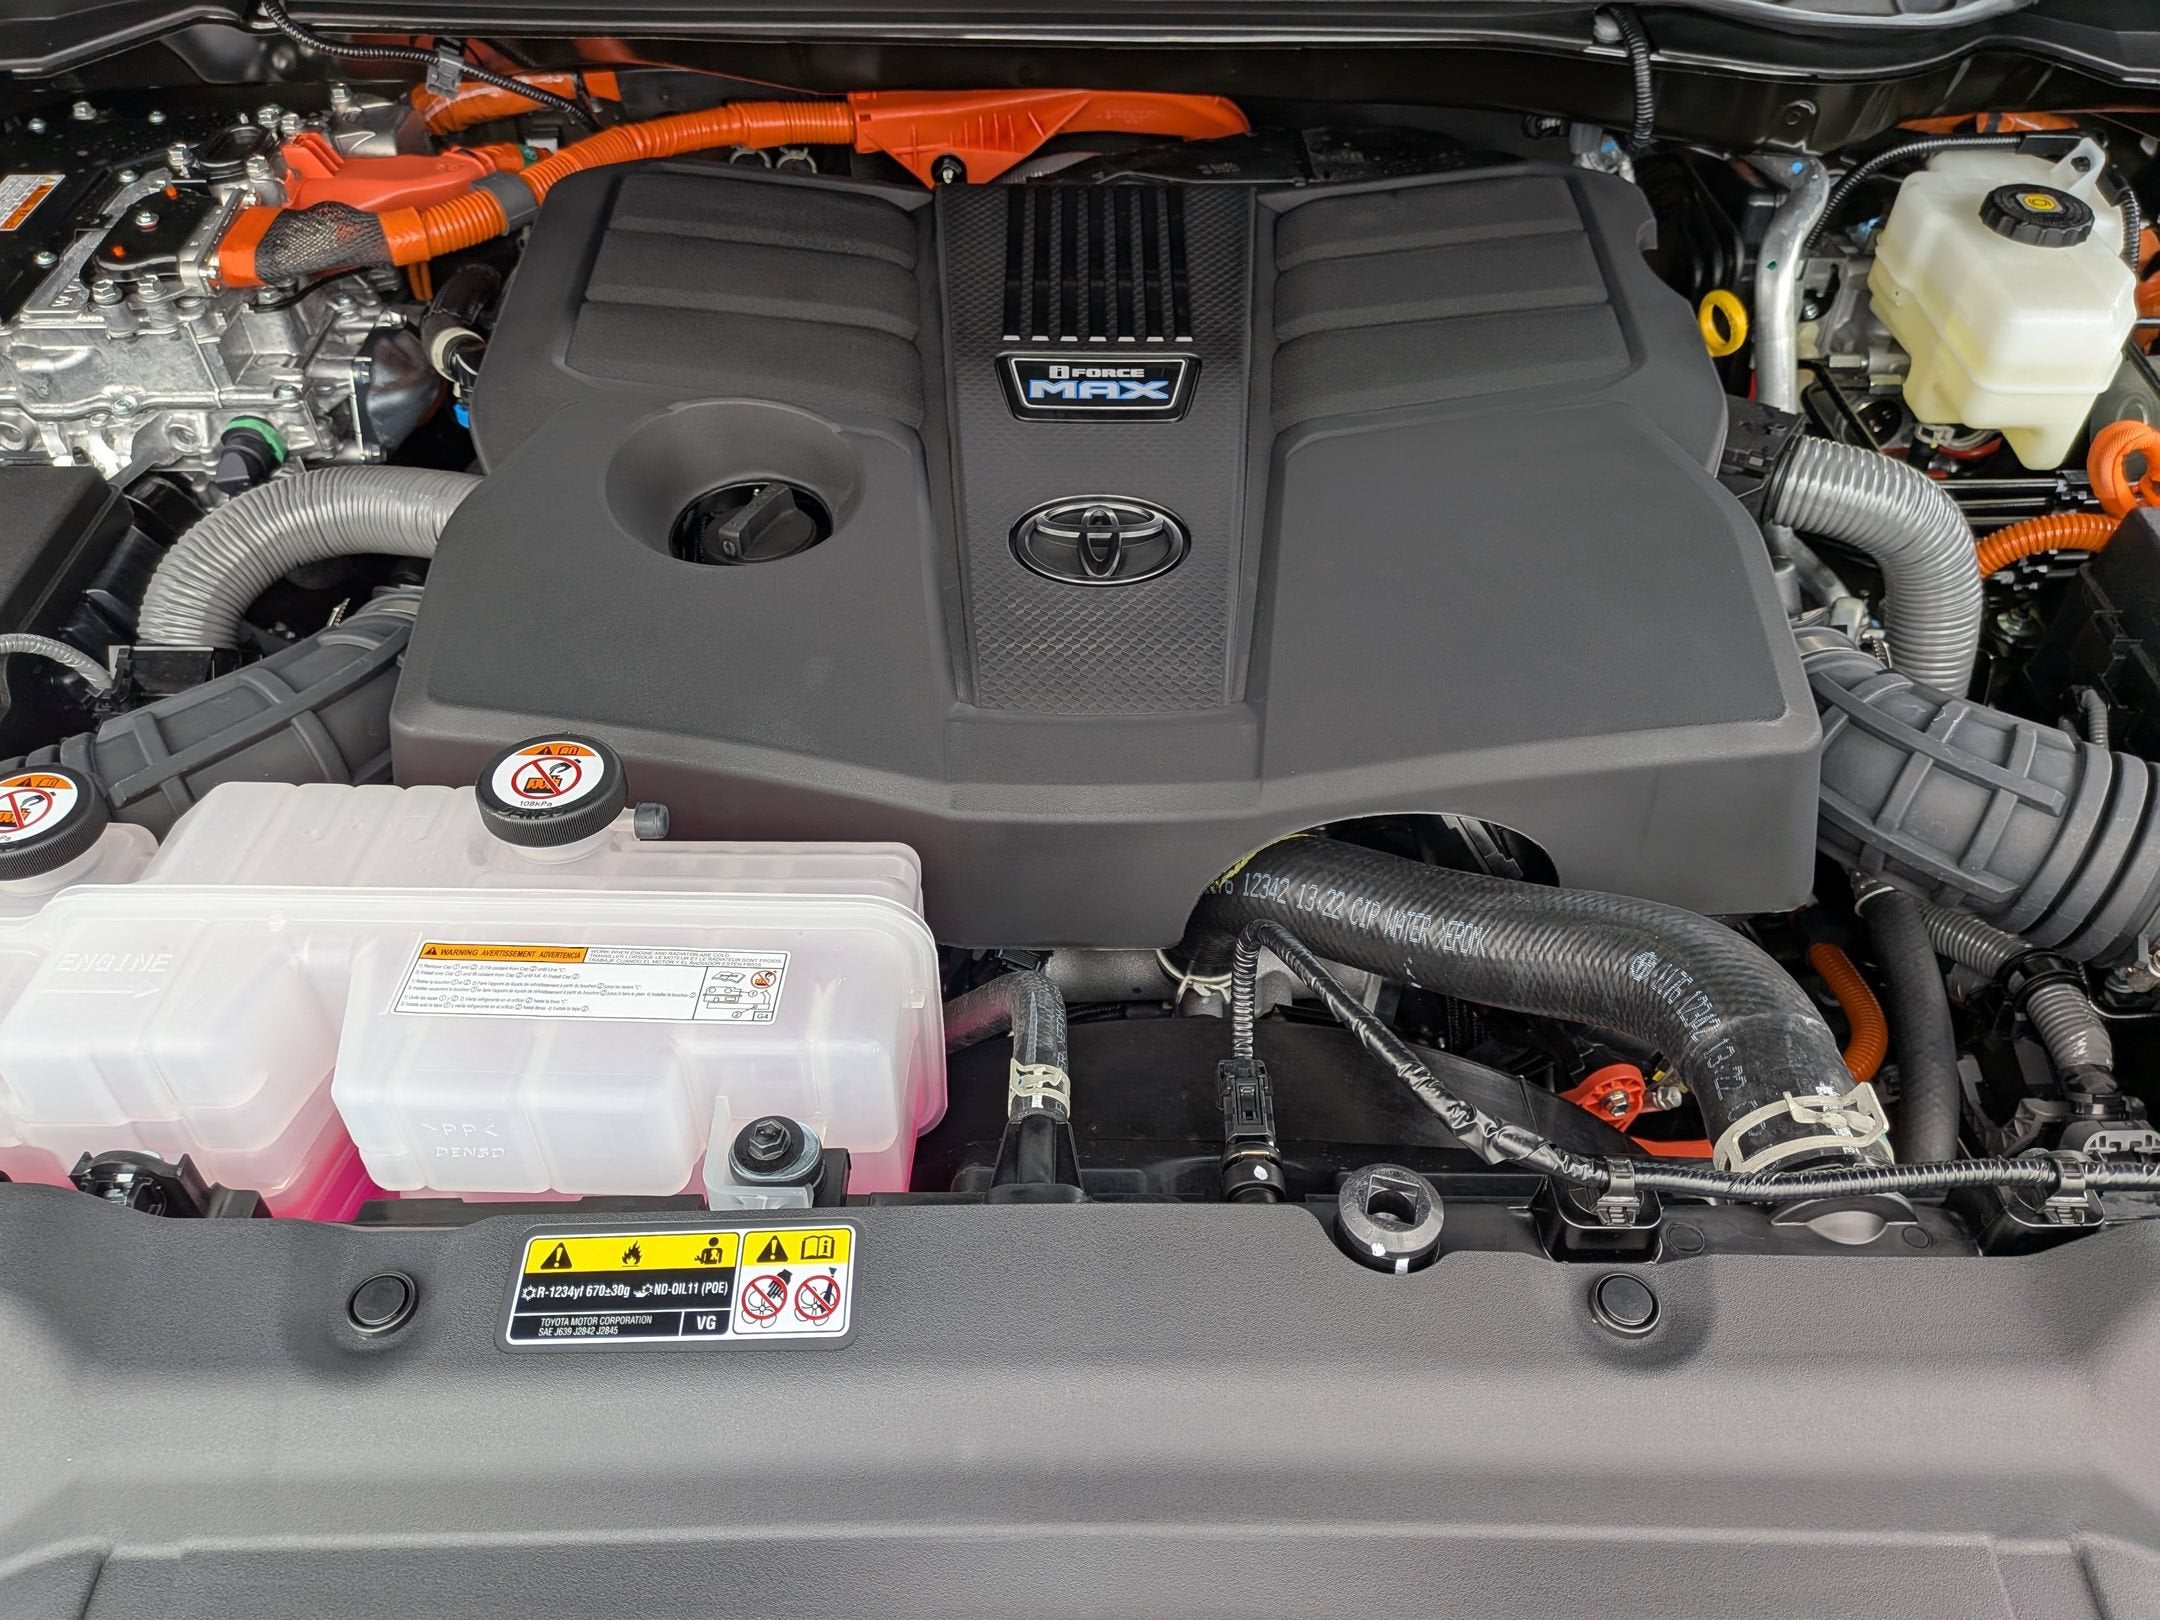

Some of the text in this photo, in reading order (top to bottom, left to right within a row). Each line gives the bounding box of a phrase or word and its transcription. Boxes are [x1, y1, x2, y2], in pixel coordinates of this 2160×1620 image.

[1071, 368, 1145, 378] FORCE
[1028, 379, 1170, 400] MAX
[1242, 872, 1290, 905] 12342
[1350, 896, 1381, 930] CIP
[1384, 907, 1432, 946] WATER
[55, 952, 174, 973] ENGINE
[435, 1146, 505, 1159] DENSO
[536, 1281, 728, 1300] R-1234yf 670±30g ND-OIL11 (POE)
[541, 1315, 717, 1330] TOYOTA MOTOR CORPORATION VG
[538, 1326, 618, 1337] SAE J639 J2842 J2845
